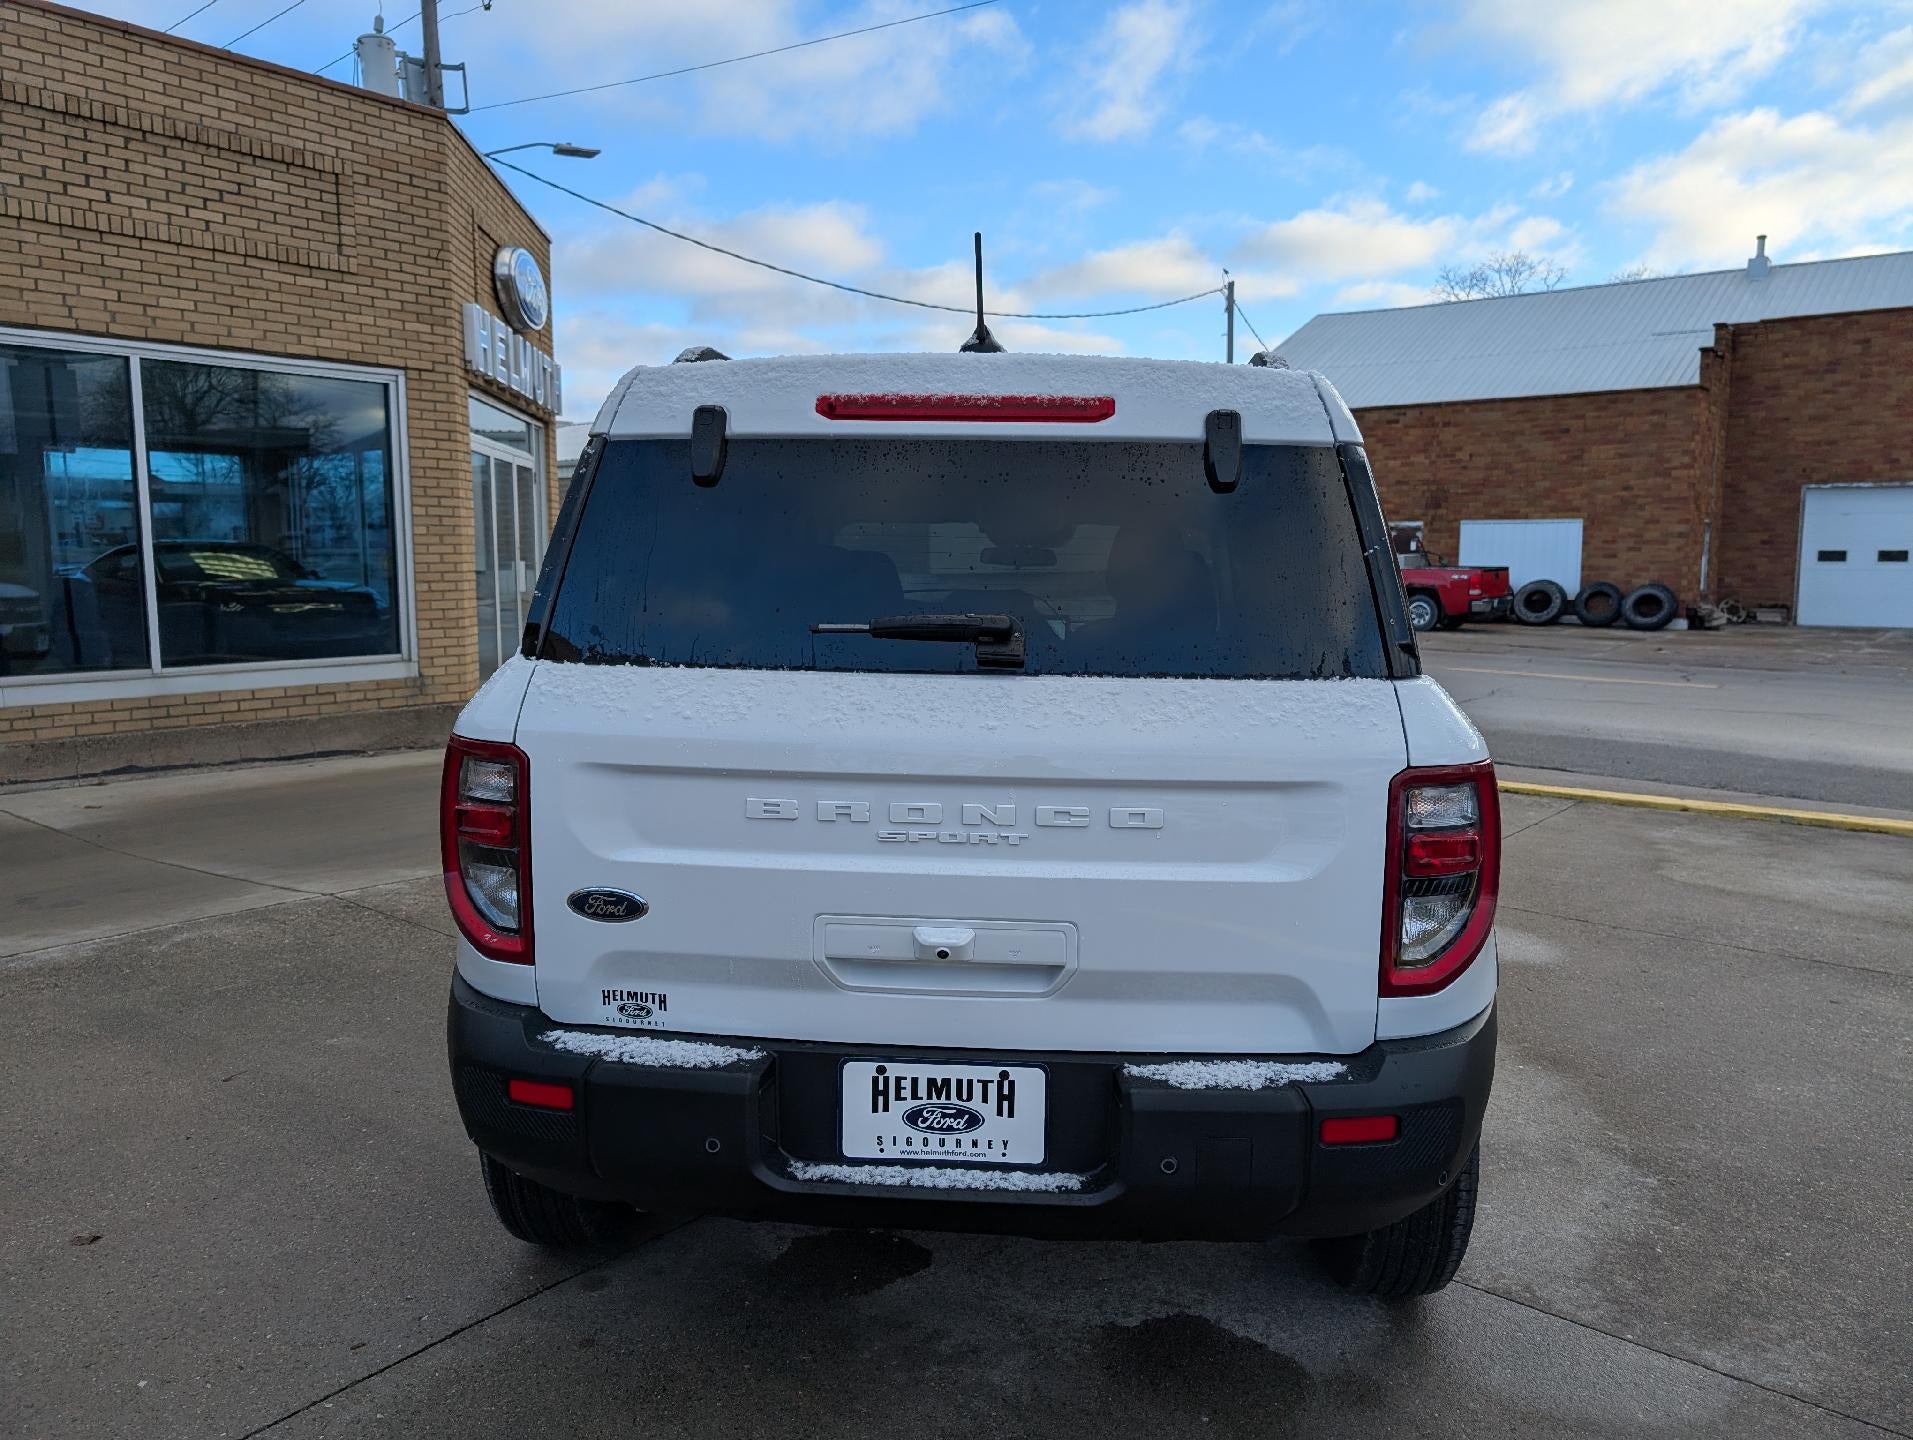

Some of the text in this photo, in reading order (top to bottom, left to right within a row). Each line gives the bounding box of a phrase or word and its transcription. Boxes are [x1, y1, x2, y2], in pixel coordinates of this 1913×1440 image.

[463, 304, 562, 416] HELMUTH
[746, 797, 1164, 828] BRONCO
[877, 830, 1029, 845] SPORT
[585, 894, 628, 916] Ford
[601, 989, 668, 1012] HELMUTH
[623, 1005, 648, 1017] Ford
[871, 1075, 1016, 1119] HELMUTH
[917, 1107, 969, 1131] Ford
[876, 1135, 1010, 1151] SIGOURNEY
[899, 1149, 987, 1159] www.helmuthford.com
